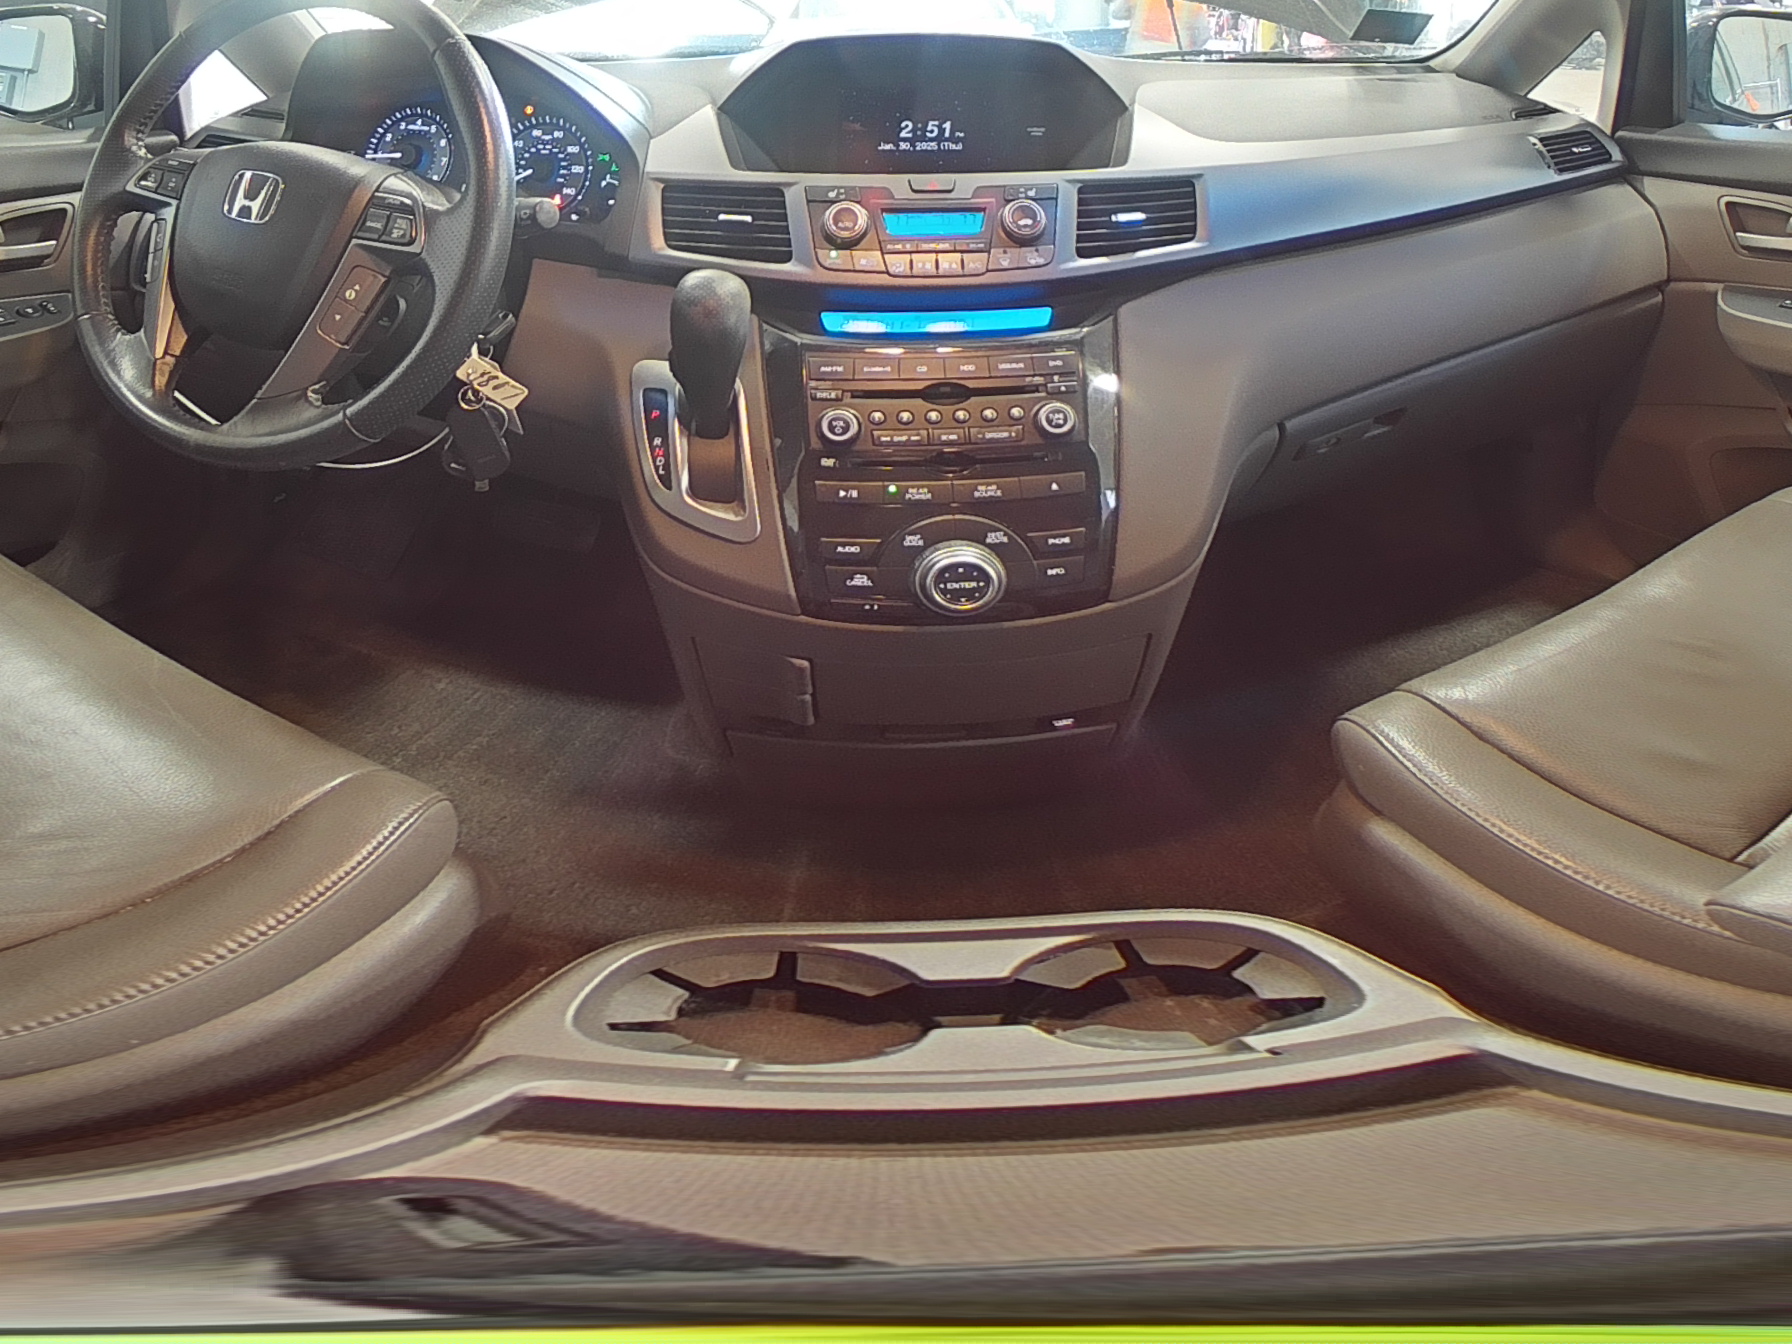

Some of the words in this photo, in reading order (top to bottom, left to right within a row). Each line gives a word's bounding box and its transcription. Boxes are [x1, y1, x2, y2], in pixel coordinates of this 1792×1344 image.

[899, 120, 952, 138] 2:51
[877, 141, 896, 150] Jan.
[898, 141, 914, 152] 30,
[915, 141, 938, 150] 2025
[940, 141, 963, 150] (Thu)
[650, 409, 661, 419] P
[653, 436, 663, 446] R
[656, 456, 665, 466] D
[658, 465, 665, 475] L
[836, 545, 861, 553] AUDIO
[846, 578, 873, 587] CANCEL
[946, 581, 978, 590] ENTER
